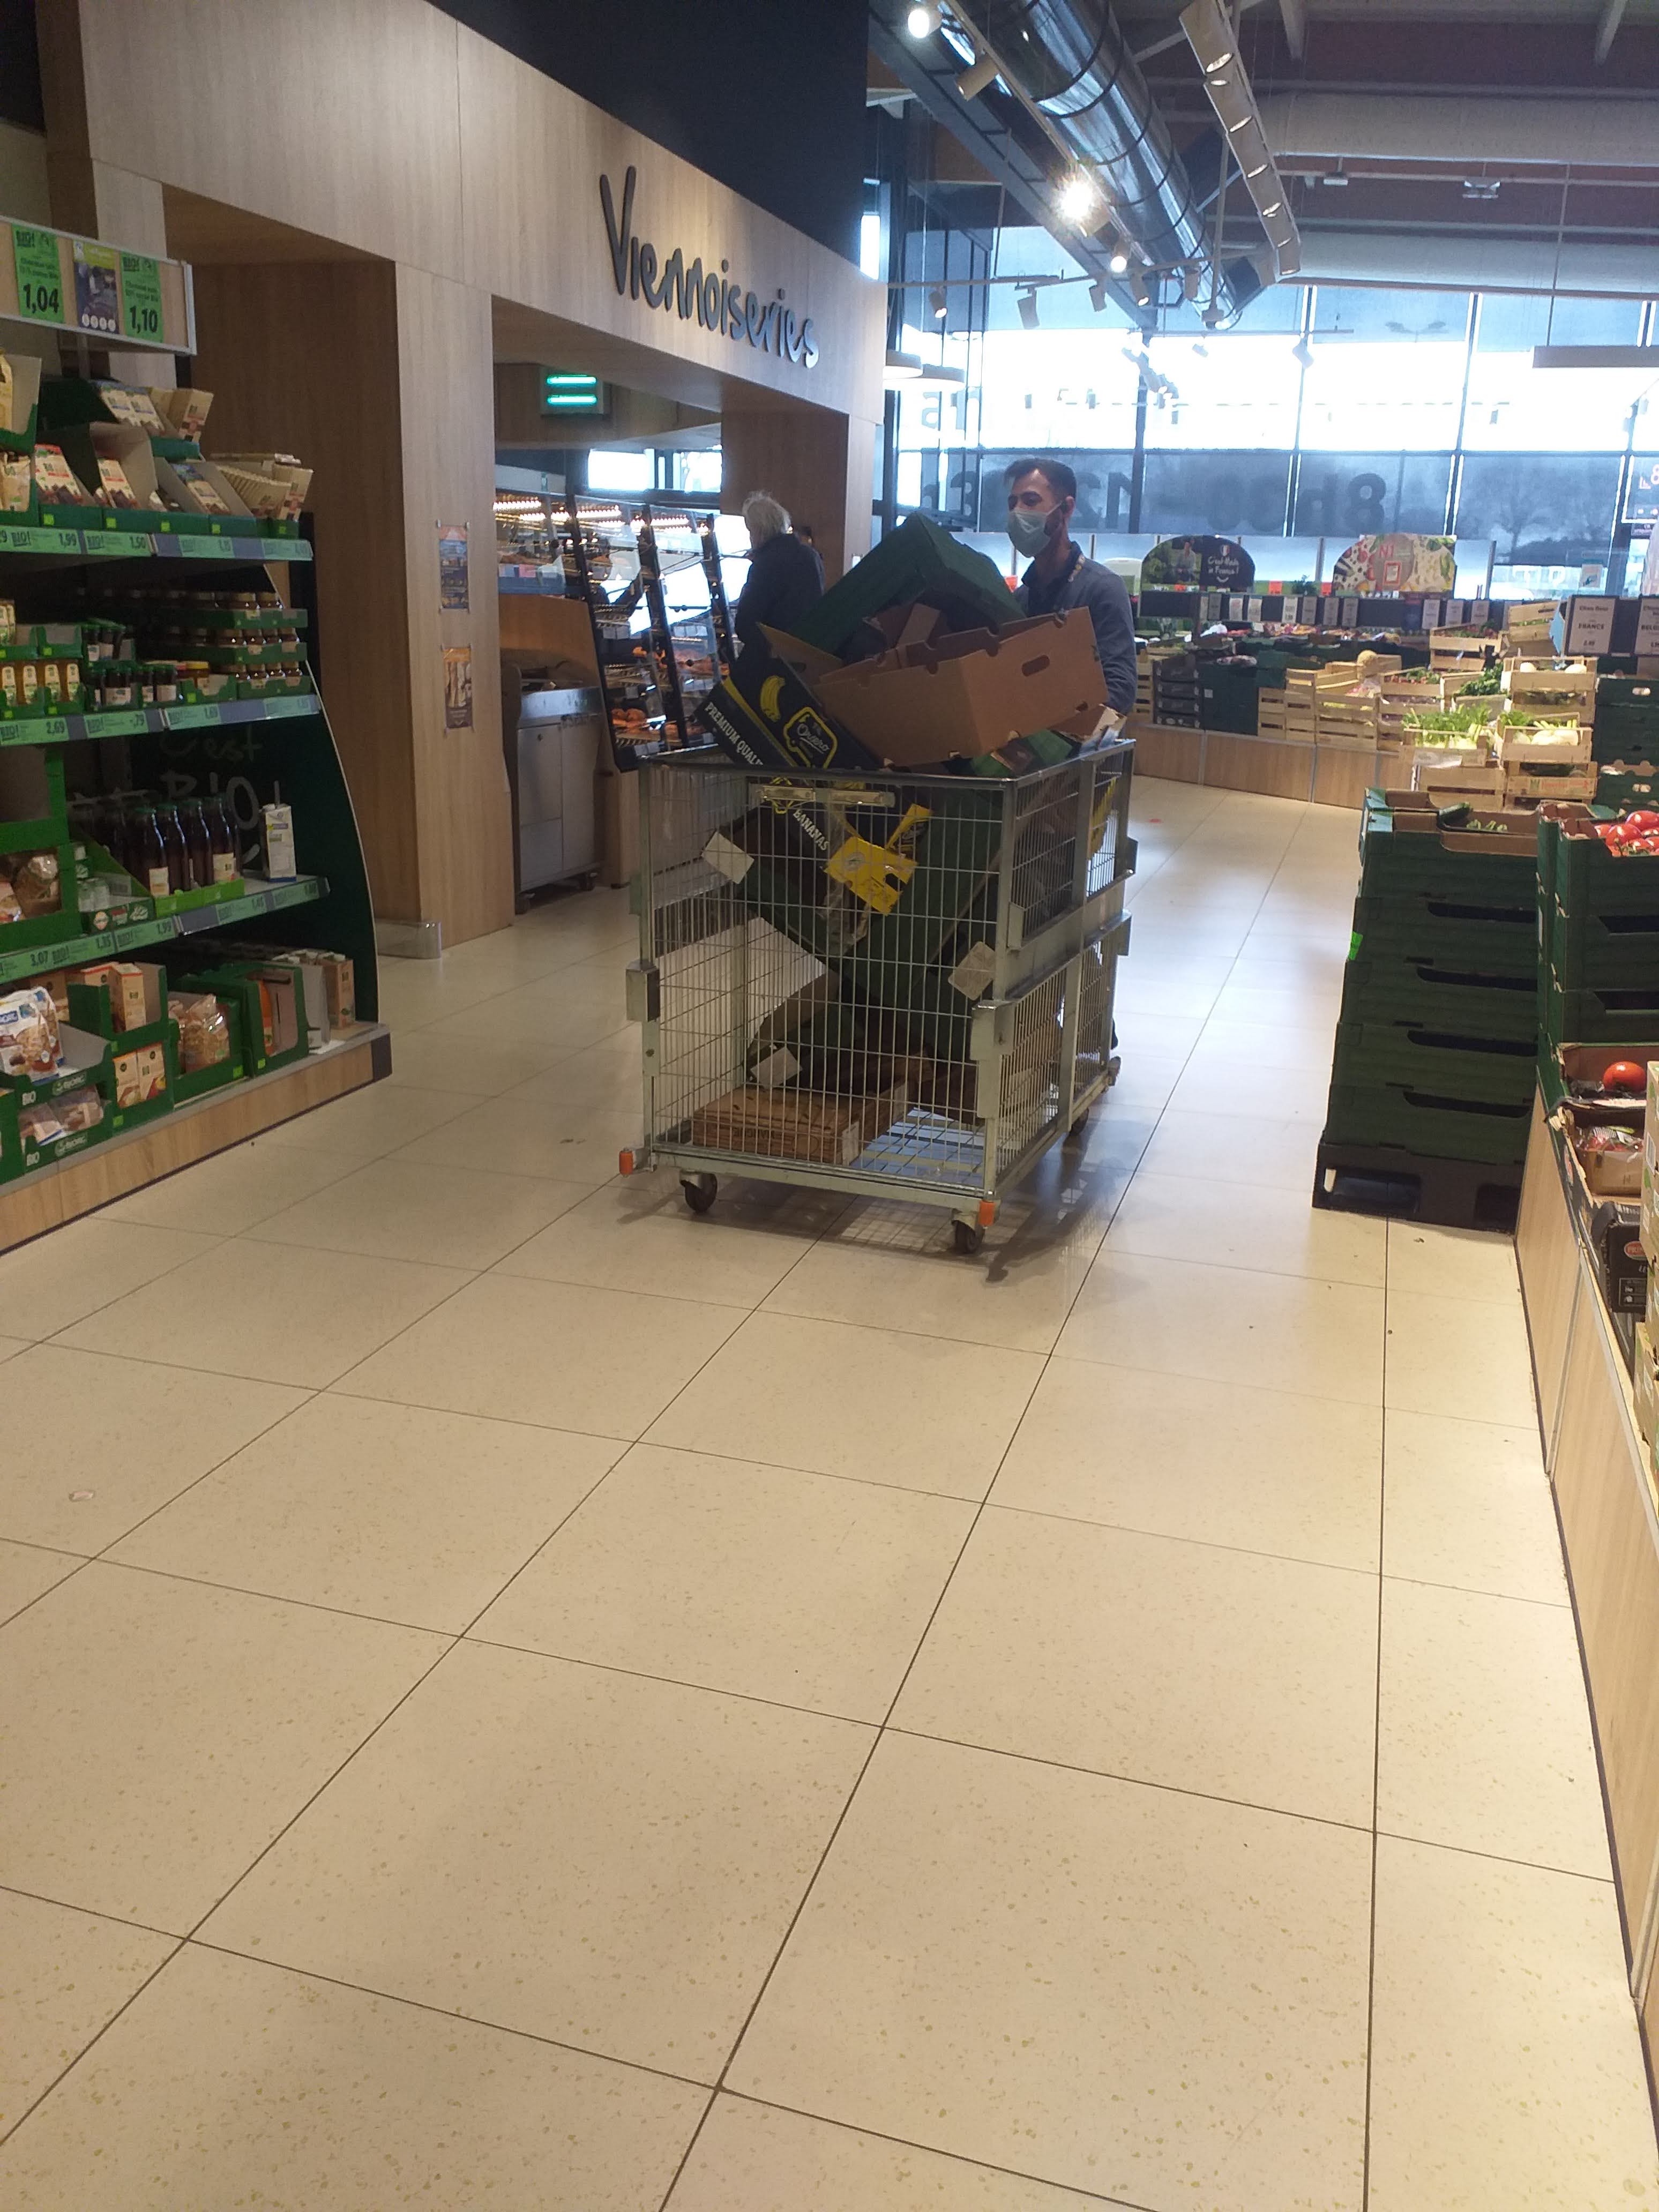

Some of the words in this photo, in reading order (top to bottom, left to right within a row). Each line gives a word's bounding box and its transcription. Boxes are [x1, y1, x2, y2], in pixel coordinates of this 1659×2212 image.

[600, 165, 820, 369] Viennoiseries
[23, 283, 59, 313] 1,04
[130, 305, 158, 333] 1,10
[705, 701, 741, 744] PREMIUM
[793, 808, 829, 851] BANANAS
